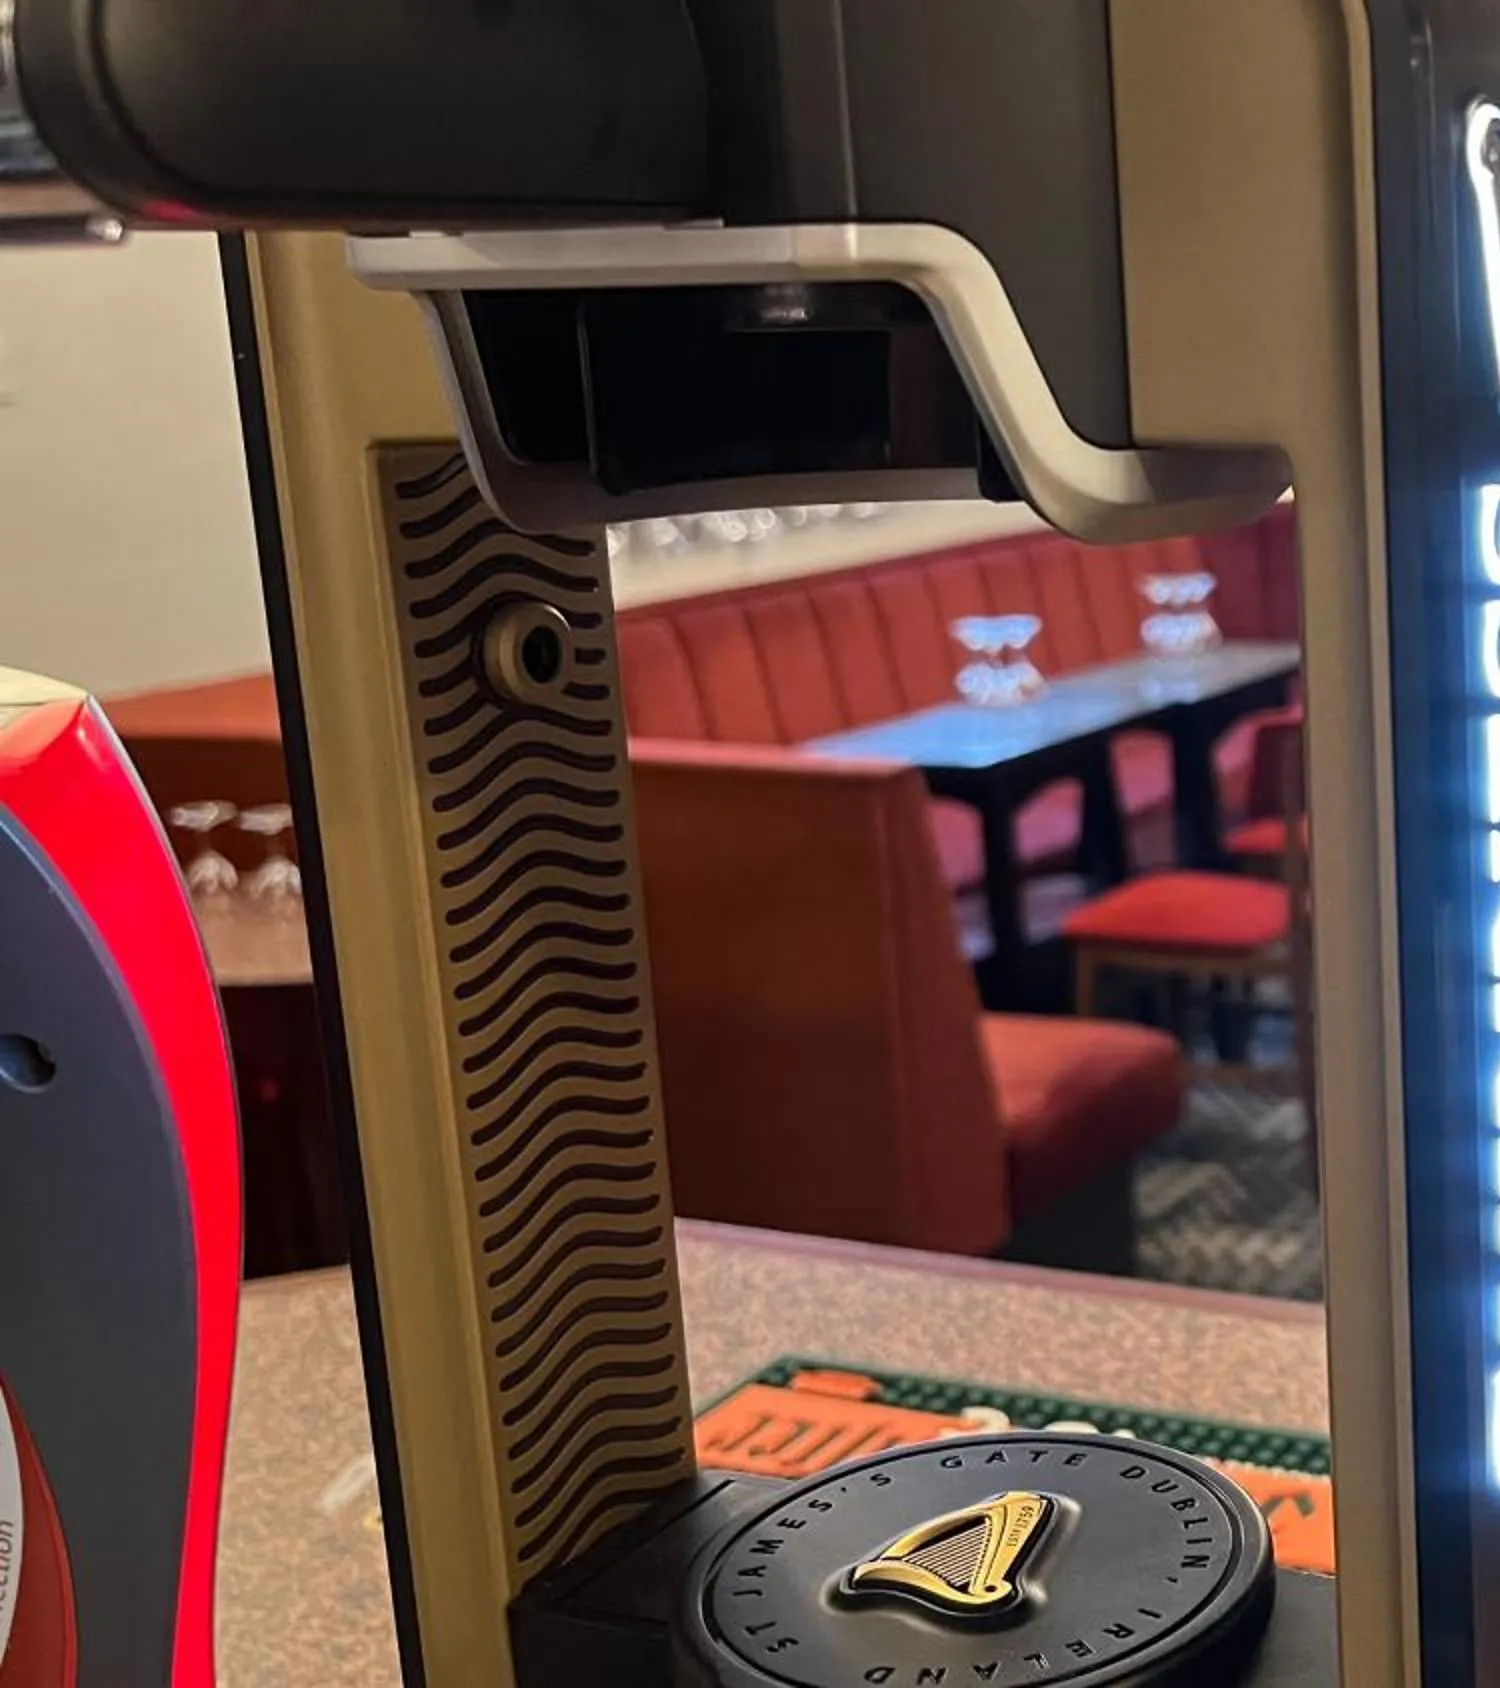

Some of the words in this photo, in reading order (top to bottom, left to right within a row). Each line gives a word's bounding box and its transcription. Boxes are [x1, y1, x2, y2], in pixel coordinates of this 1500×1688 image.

[939, 1449, 1088, 1469] GATE
[732, 1472, 892, 1597] JAMES'S
[744, 1621, 799, 1653] ST
[864, 1608, 1162, 1684] IRELAND
